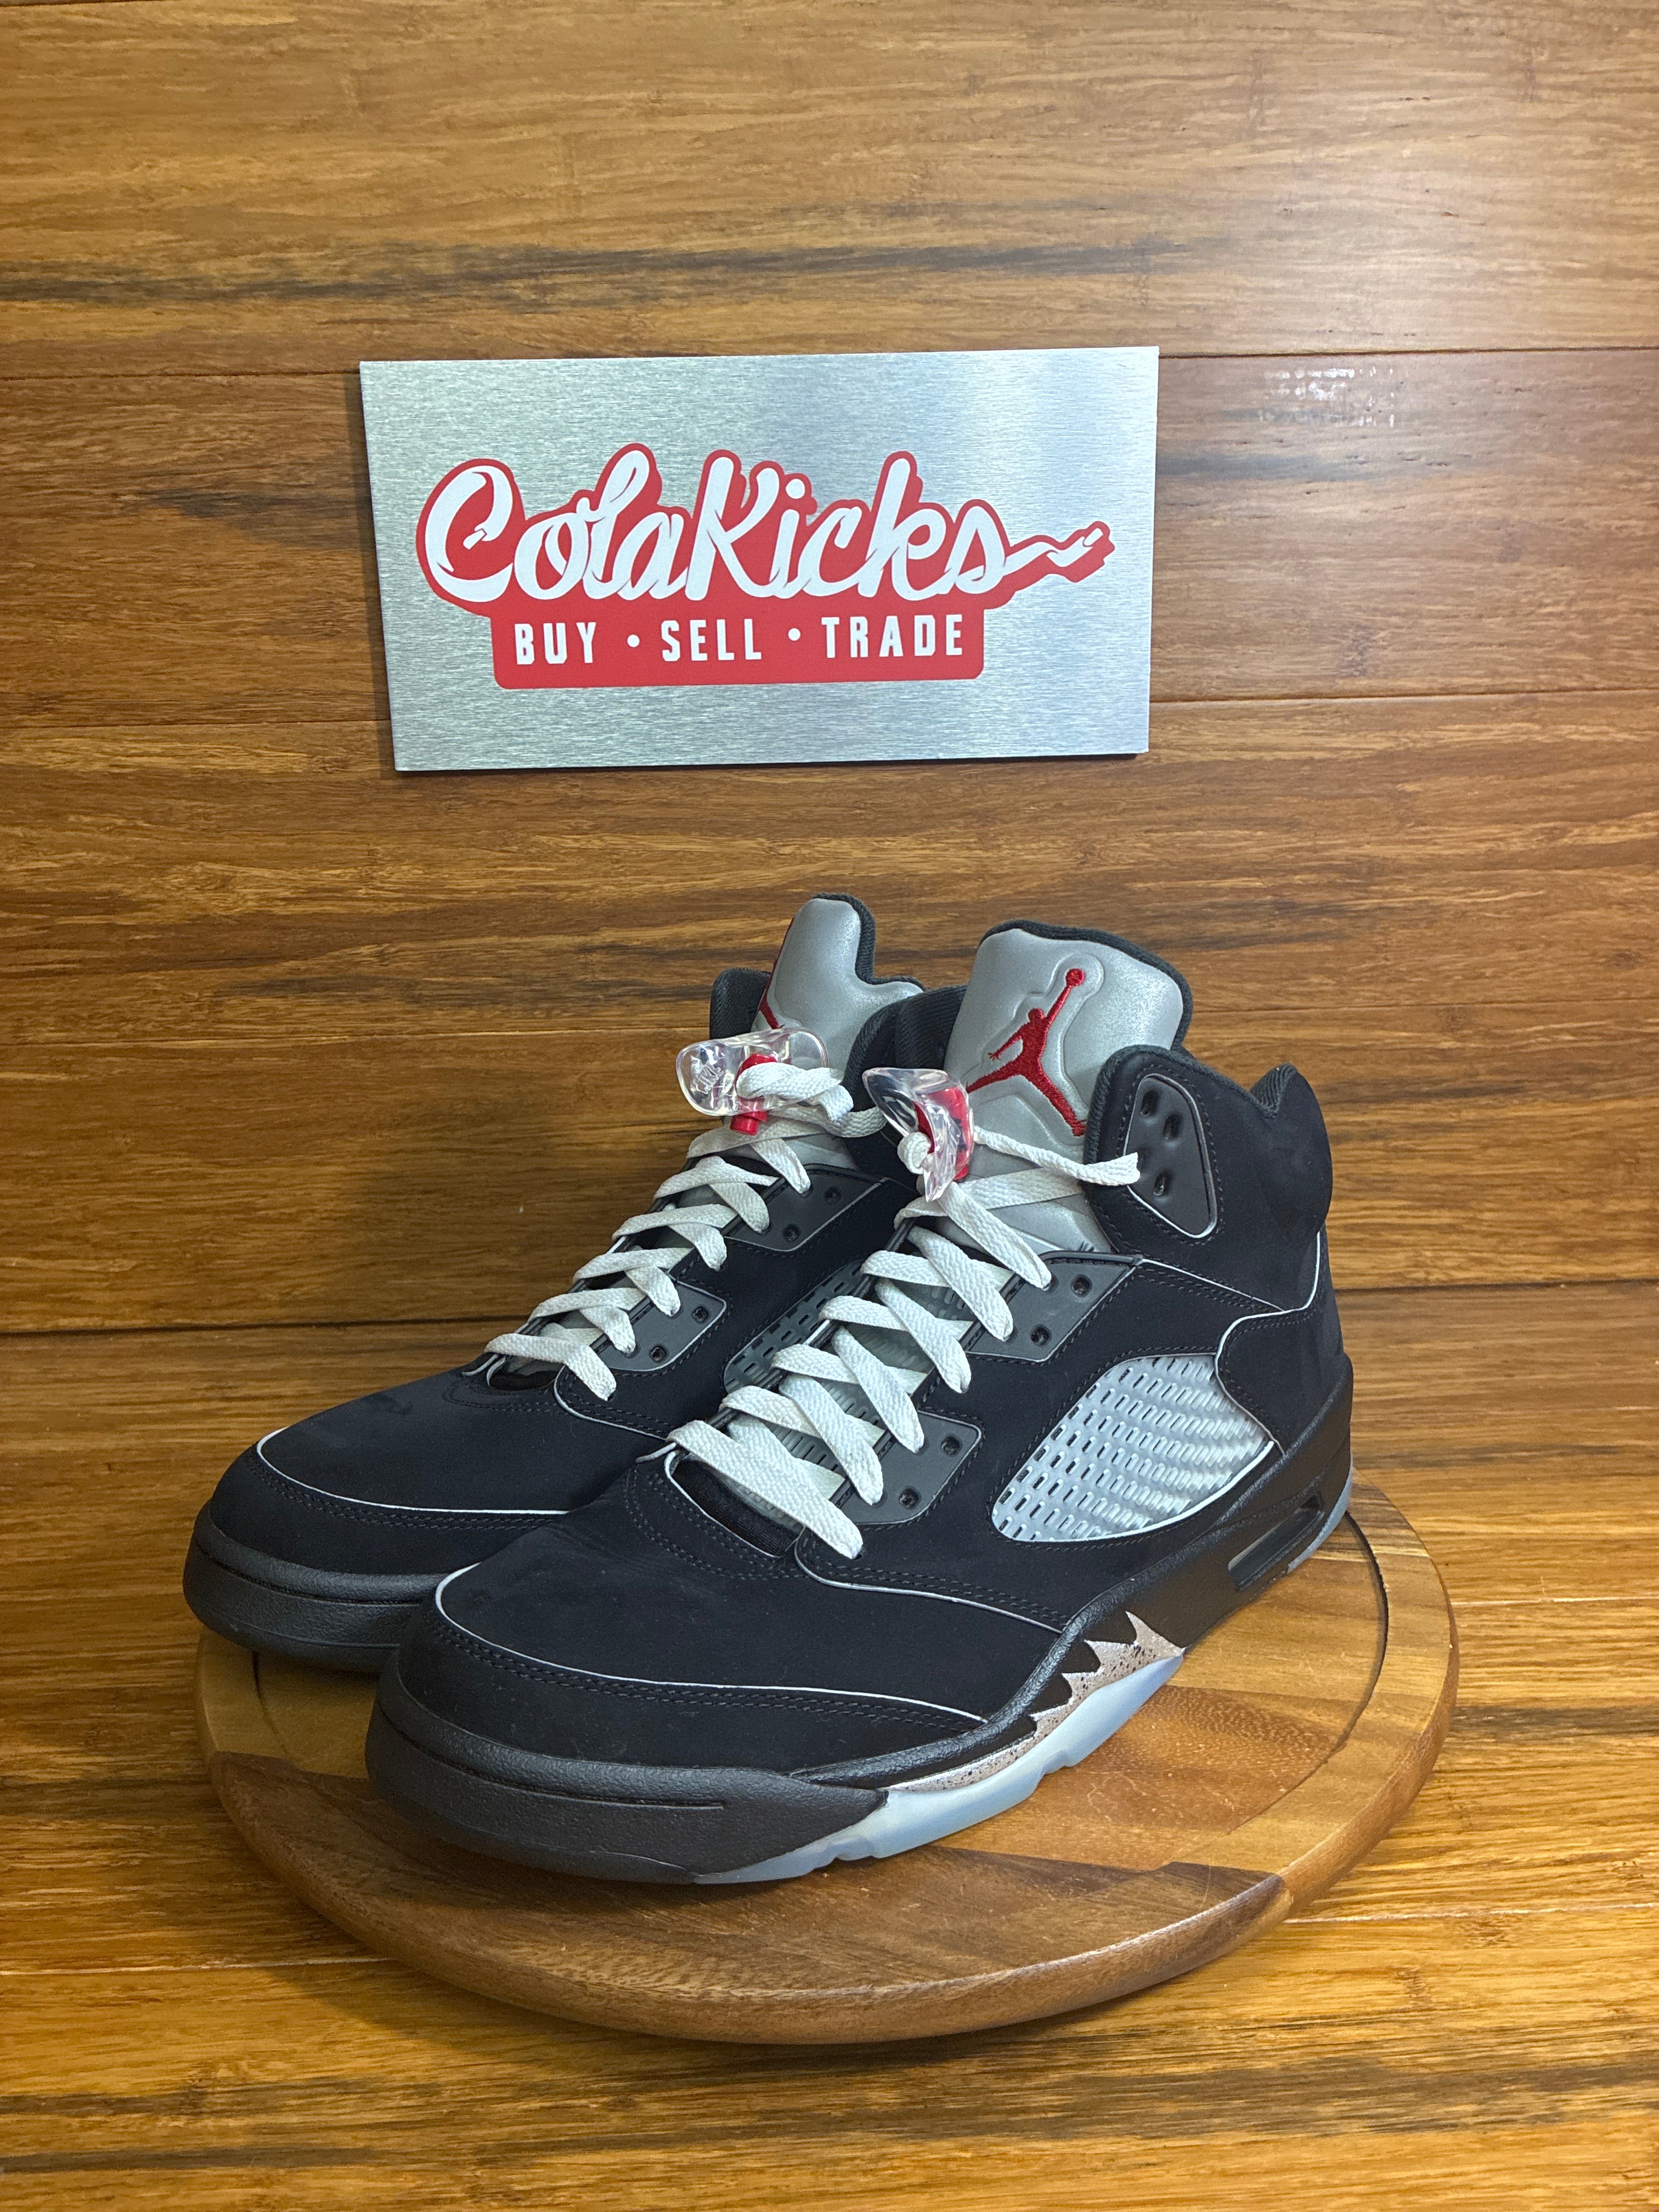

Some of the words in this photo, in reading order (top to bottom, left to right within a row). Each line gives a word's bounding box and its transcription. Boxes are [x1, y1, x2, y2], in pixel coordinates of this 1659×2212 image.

[425, 449, 1009, 602] ColaKicks
[514, 622, 596, 665] BUY
[661, 618, 762, 662] SELL
[821, 614, 963, 658] TRADE
[690, 1064, 724, 1094] NIKE
